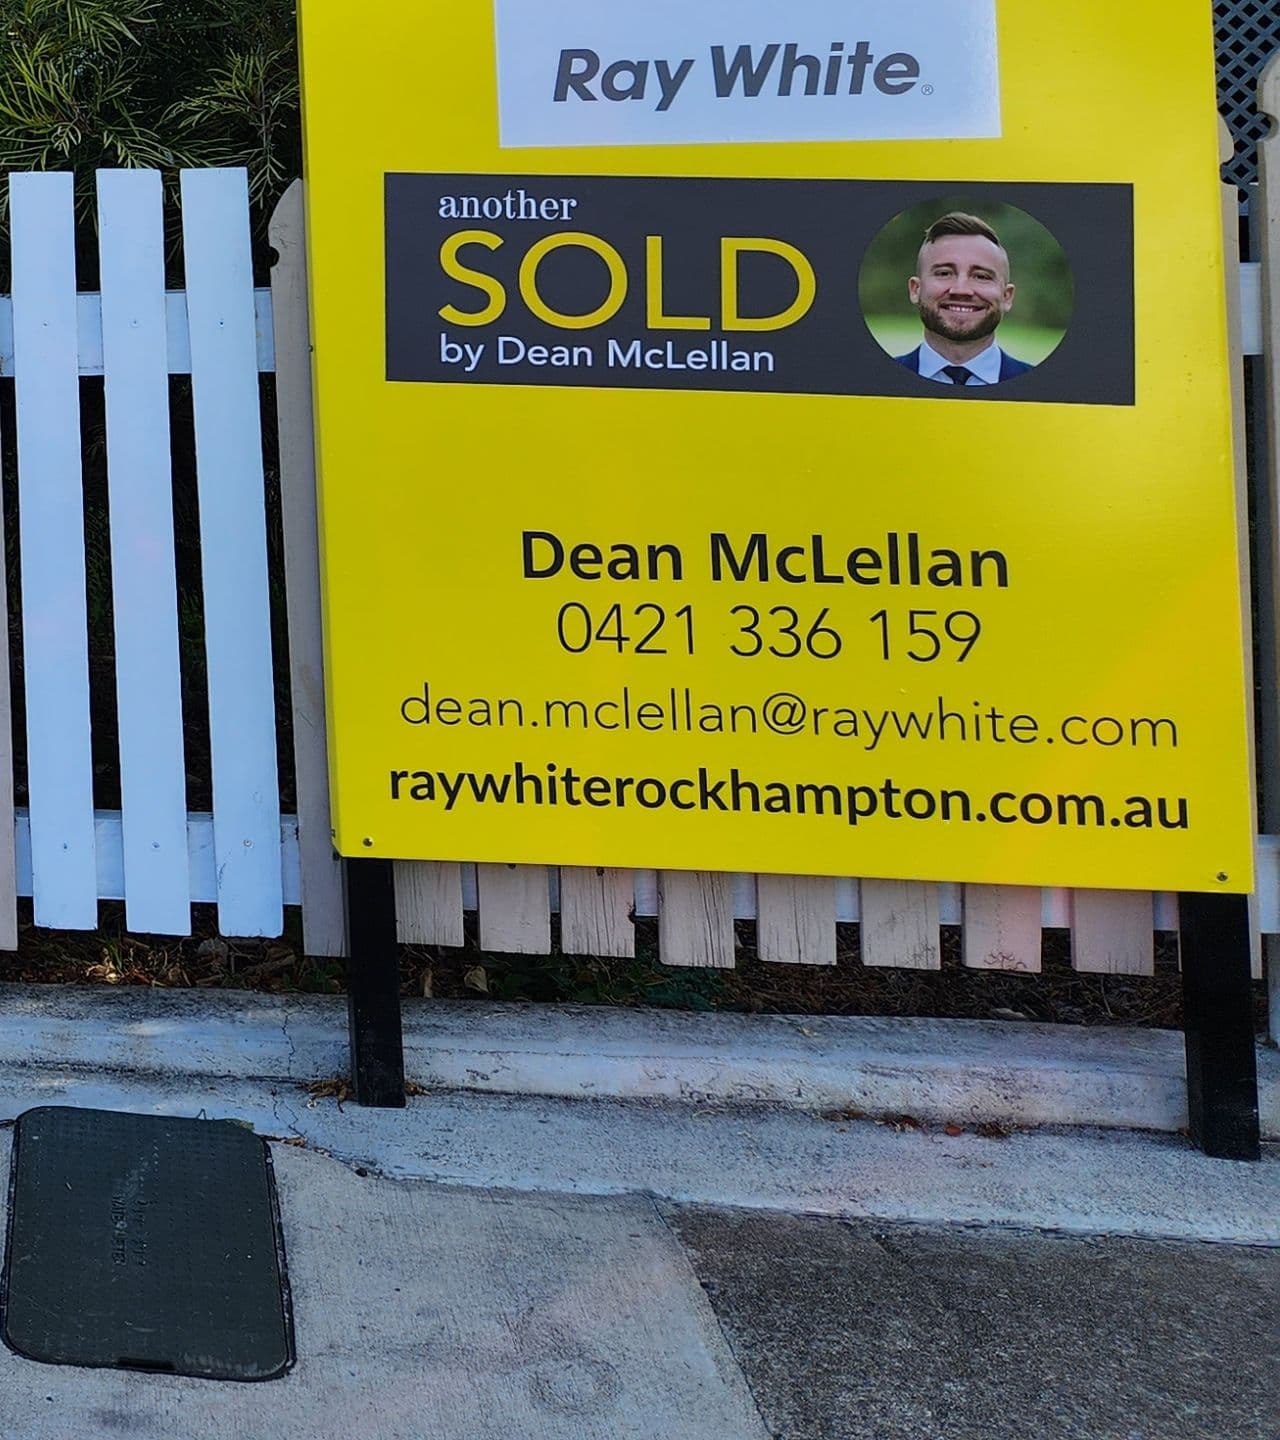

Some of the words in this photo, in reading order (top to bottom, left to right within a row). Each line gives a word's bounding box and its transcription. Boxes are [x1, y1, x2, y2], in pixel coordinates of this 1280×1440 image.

[554, 49, 695, 111] Ray
[439, 190, 577, 220] another
[439, 231, 815, 331] SOLD
[441, 333, 484, 371] by
[498, 337, 592, 366] Dean
[608, 340, 773, 371] McLellan
[522, 531, 682, 580] Dean
[711, 533, 1008, 587] McLellan
[558, 602, 693, 654] 0421
[730, 605, 841, 659] 336
[870, 610, 981, 662] 159
[401, 682, 1177, 750] dean.mclellan@raywhite.com
[391, 762, 1188, 828] raywhiterockhampton.com.au
